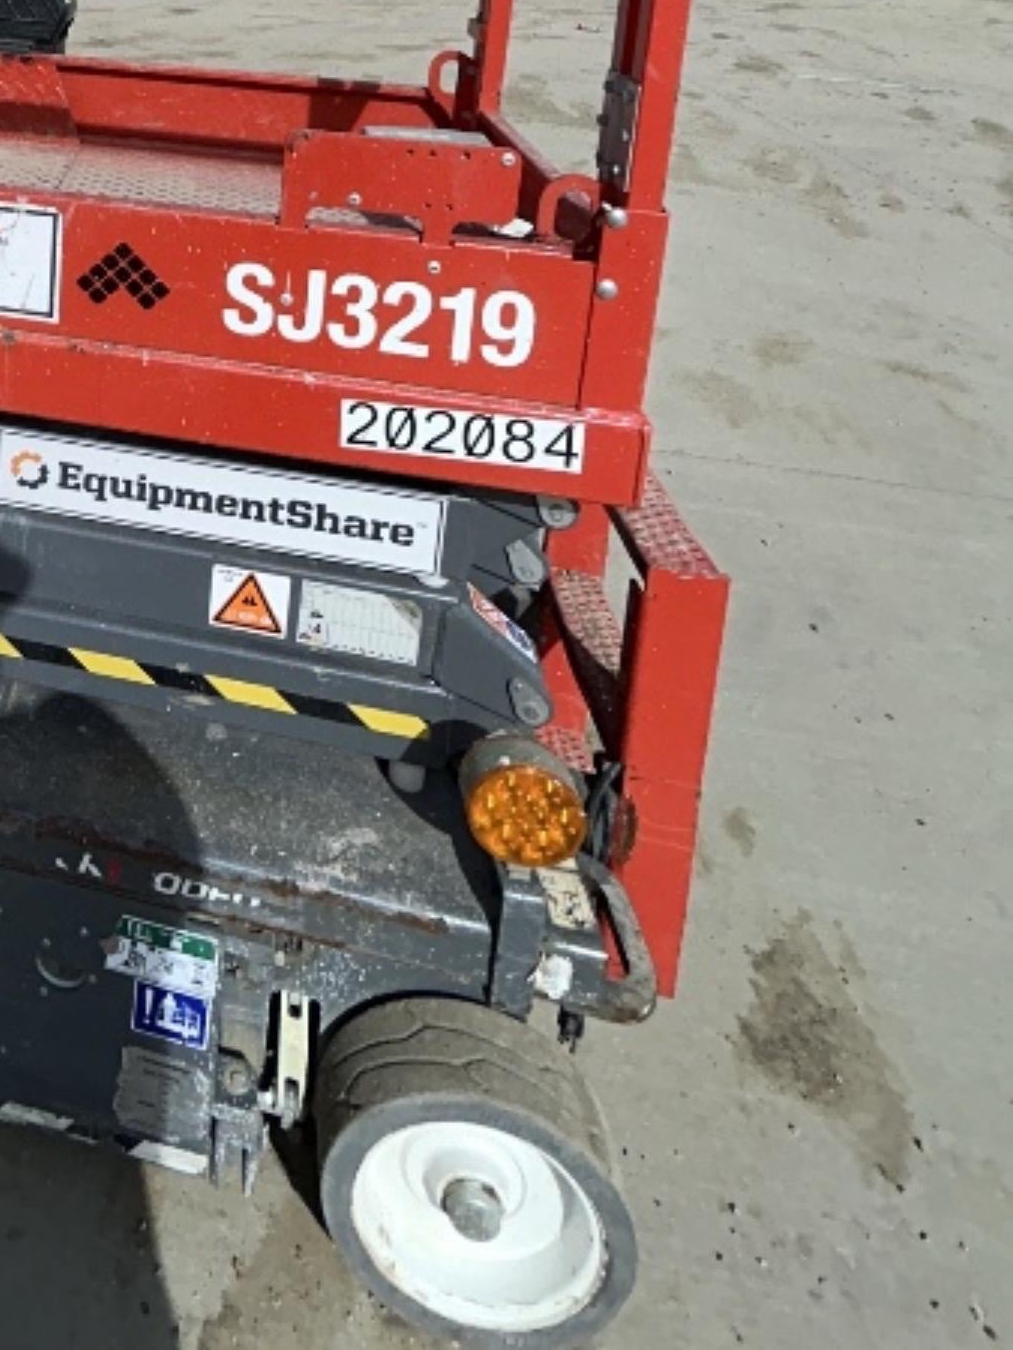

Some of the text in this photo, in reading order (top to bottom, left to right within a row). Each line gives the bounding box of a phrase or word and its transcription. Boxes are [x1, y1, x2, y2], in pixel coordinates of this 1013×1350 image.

[223, 263, 536, 367] SJ3219
[346, 402, 579, 468] 202084
[57, 461, 415, 547] EquipmentShare
